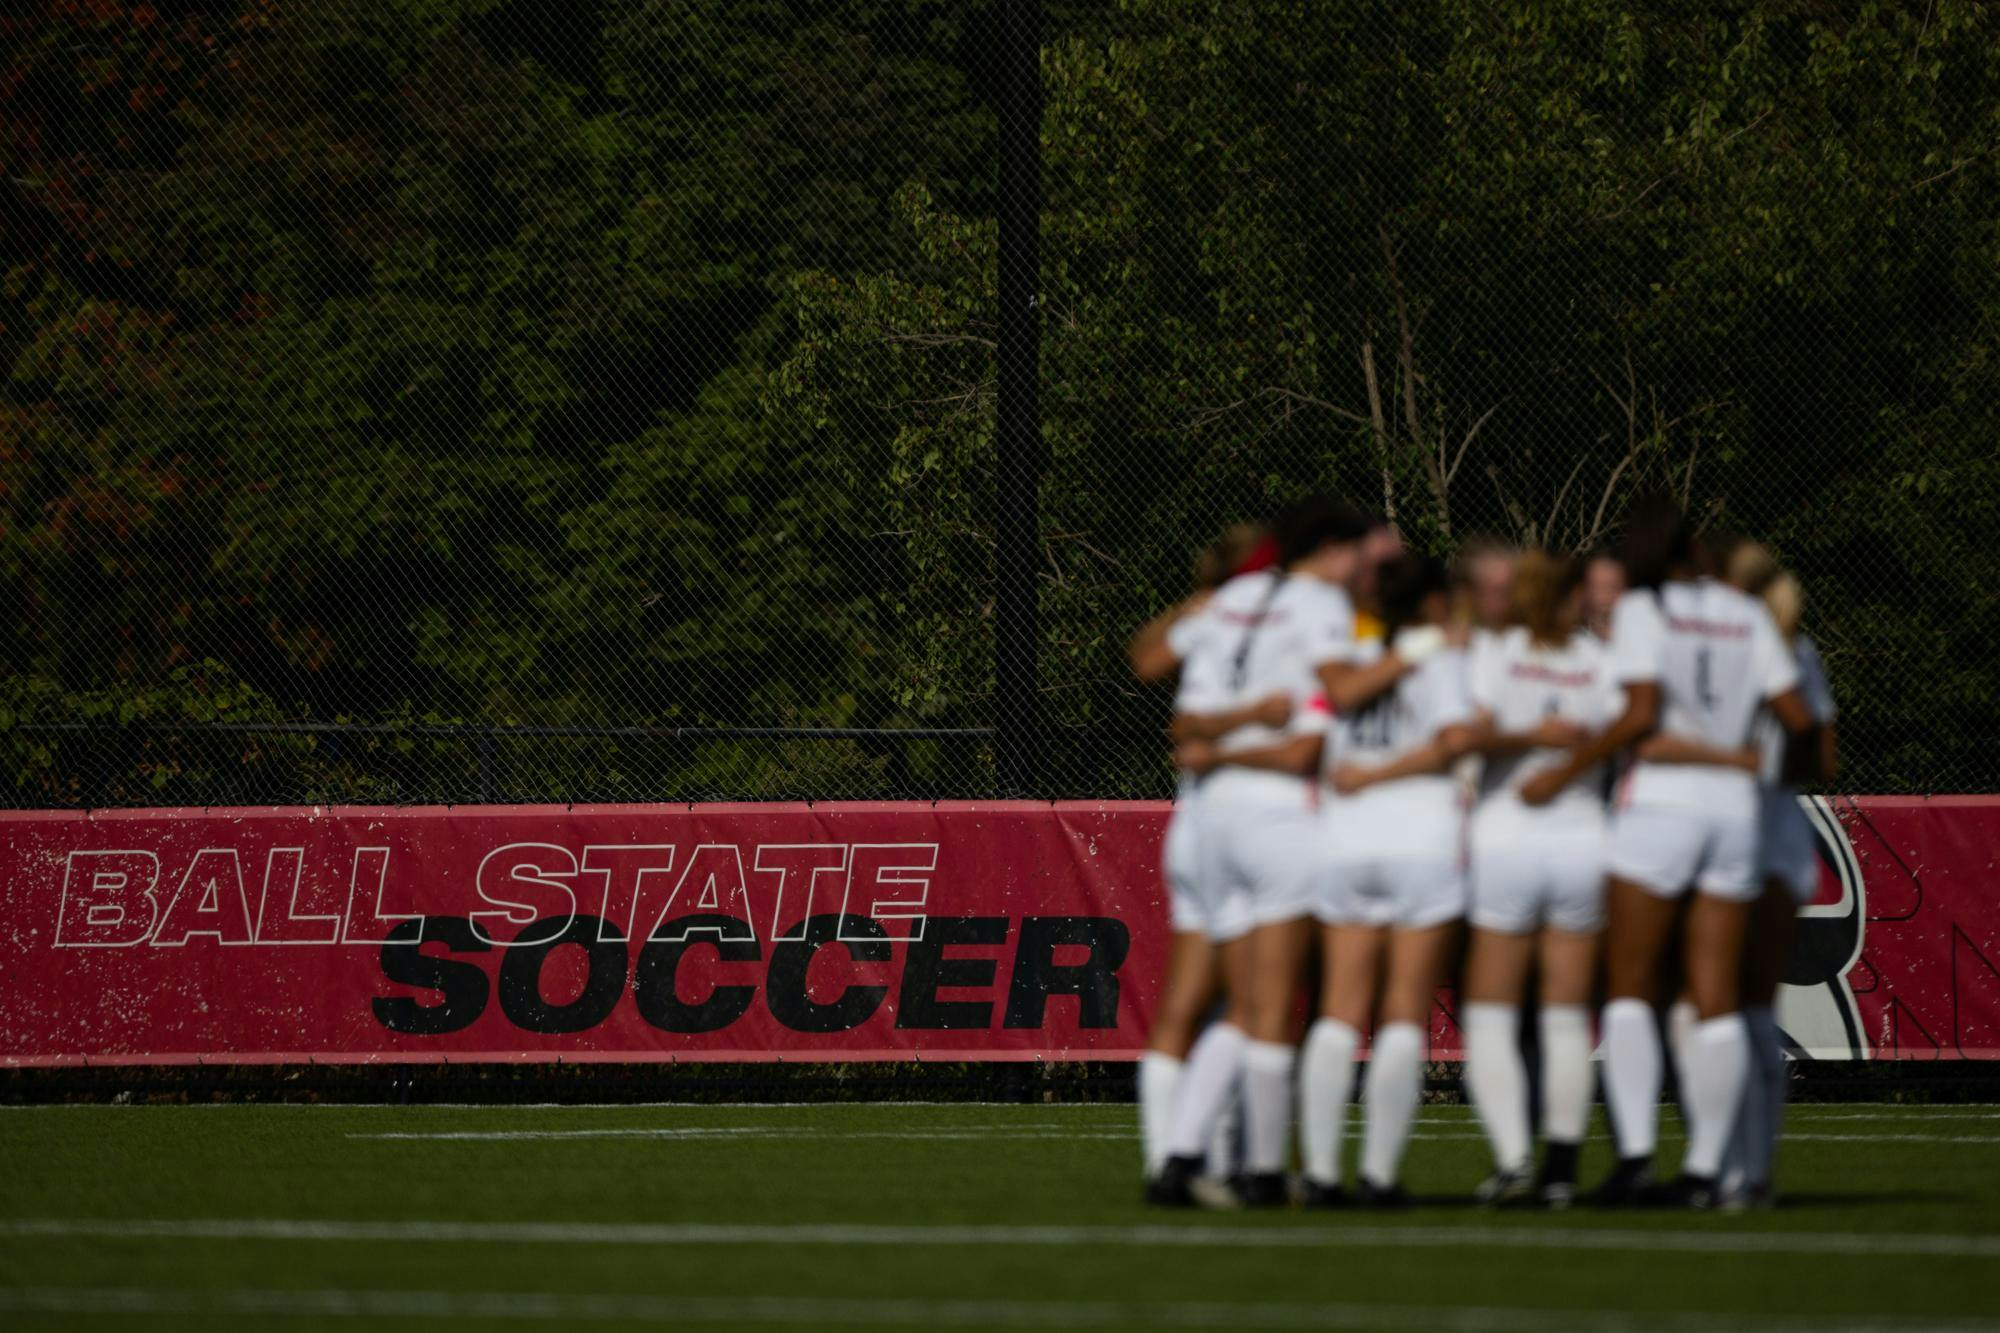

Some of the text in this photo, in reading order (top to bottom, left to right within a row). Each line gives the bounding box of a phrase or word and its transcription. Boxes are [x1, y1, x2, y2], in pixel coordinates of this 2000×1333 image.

[53, 842, 939, 947] BALL STATE
[372, 914, 1130, 1034] SOCCER
